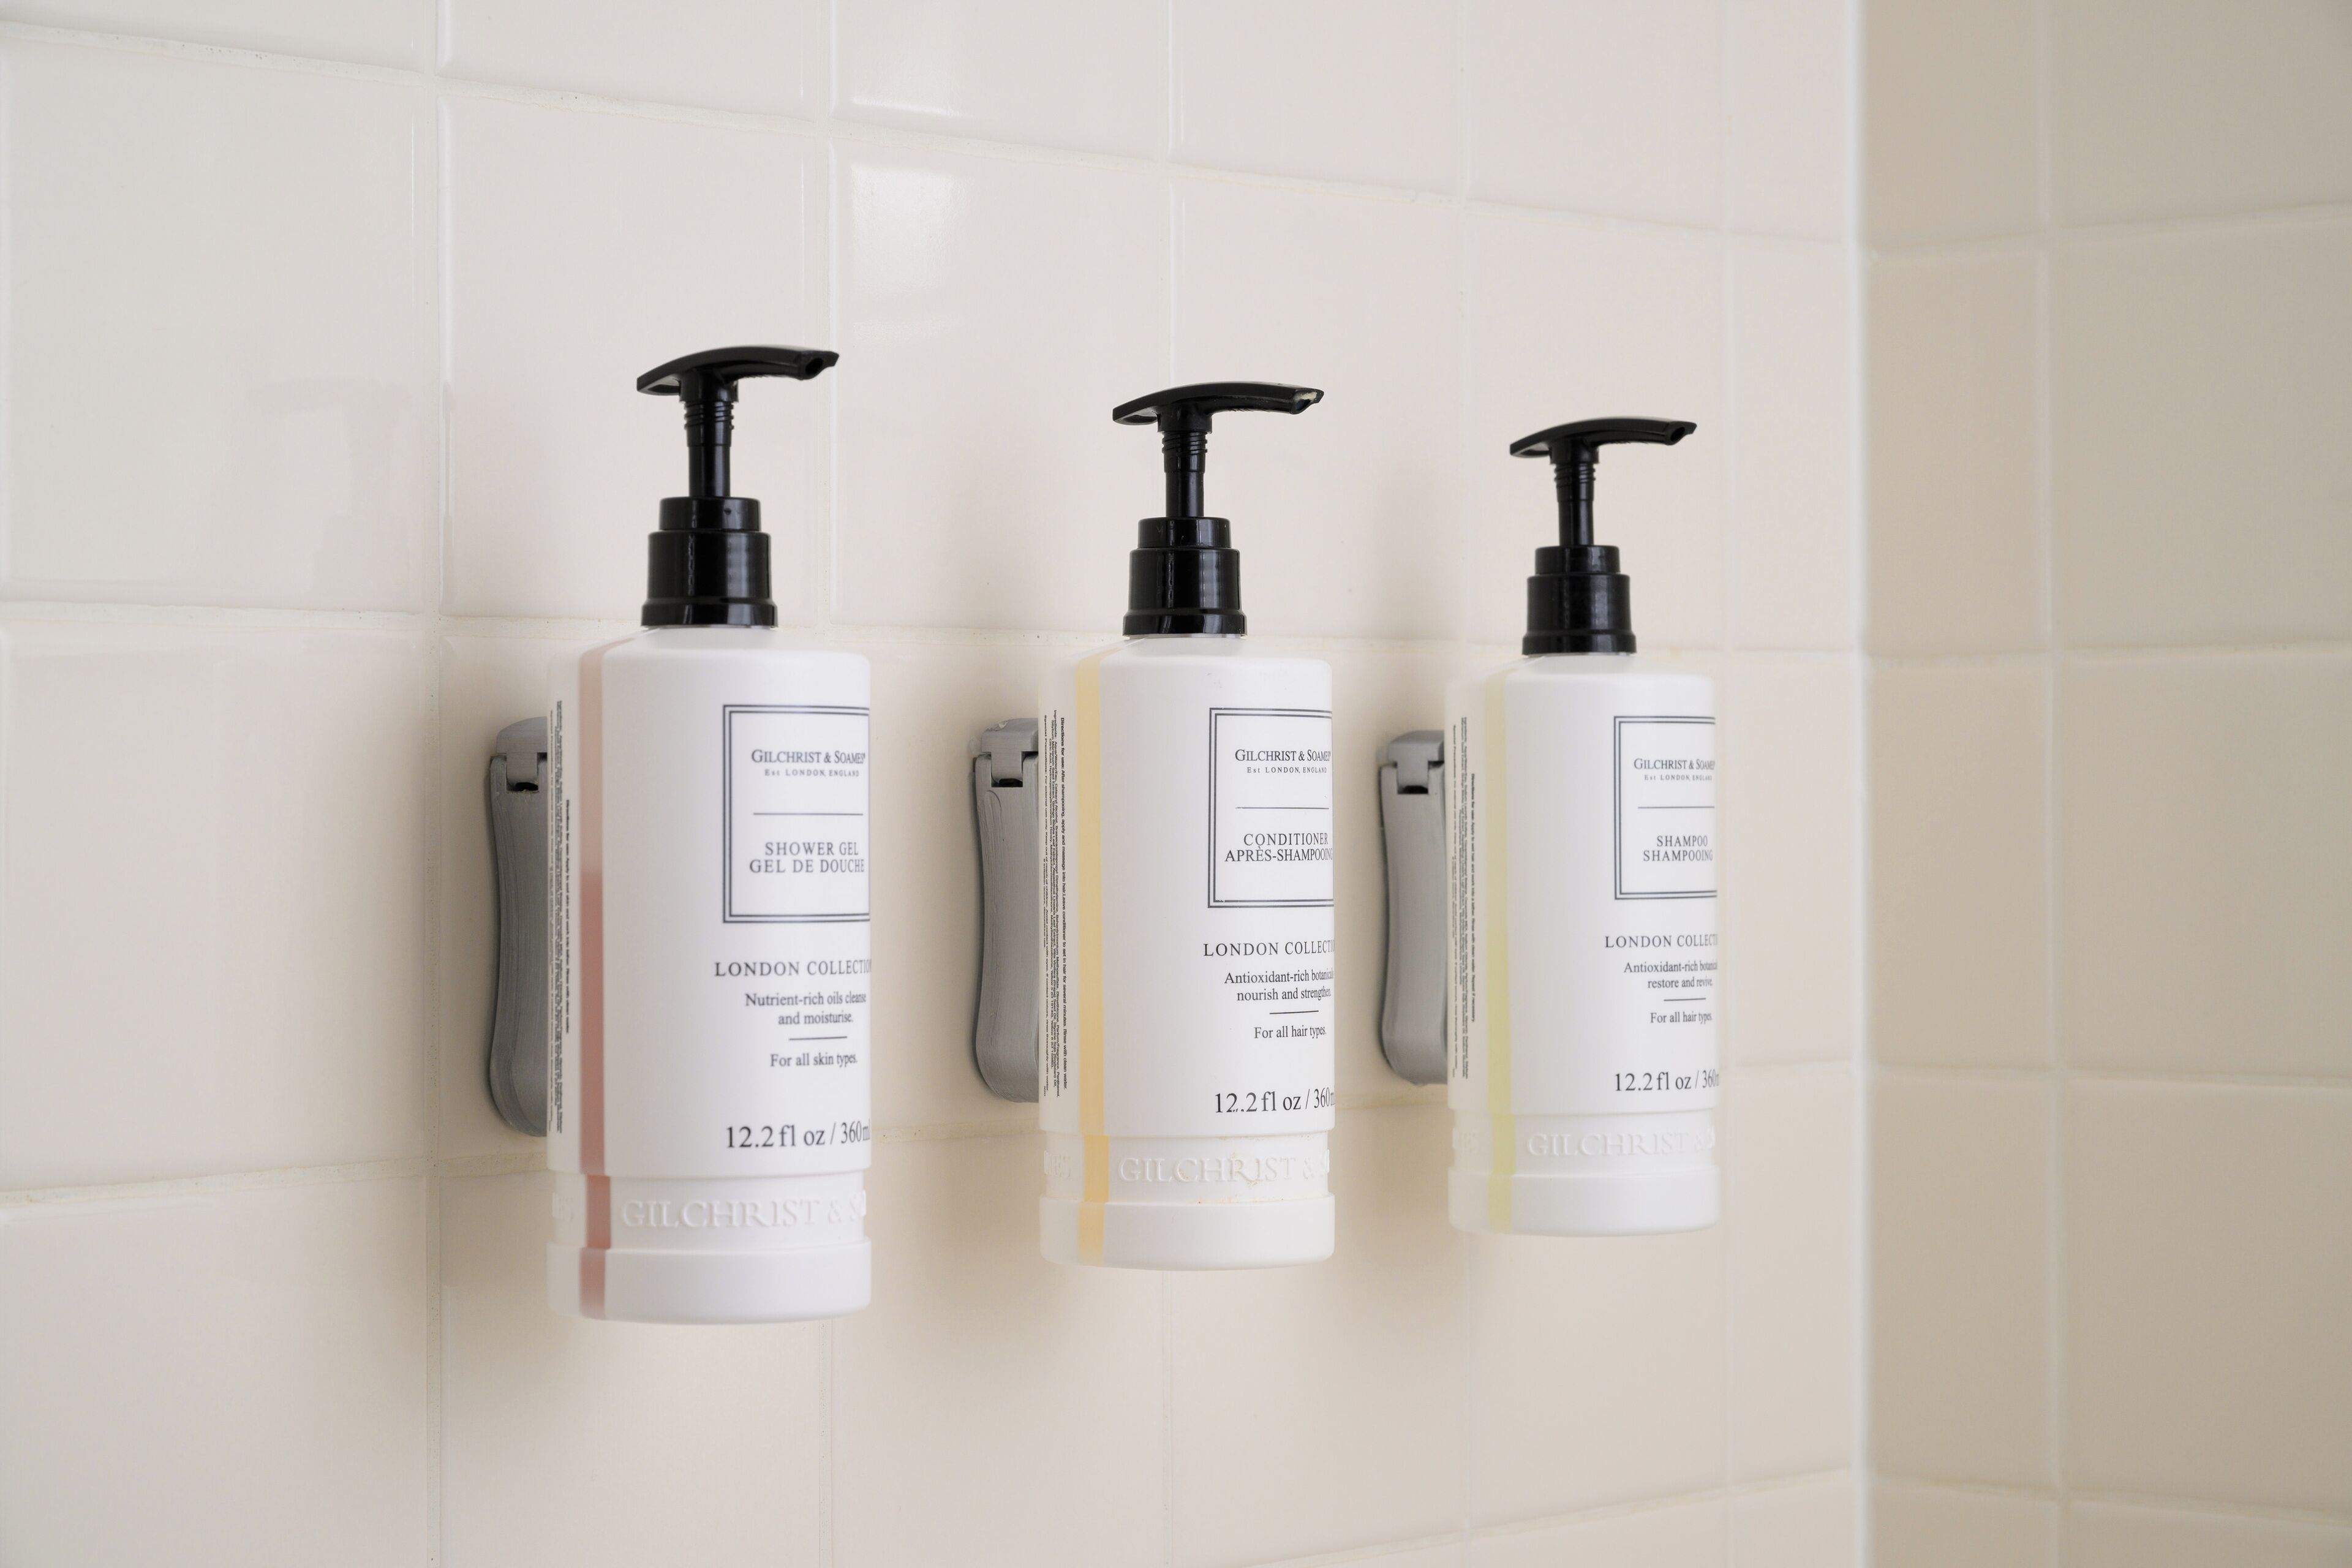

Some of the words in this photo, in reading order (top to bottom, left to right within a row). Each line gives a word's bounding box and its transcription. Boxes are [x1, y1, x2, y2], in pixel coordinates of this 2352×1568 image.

[752, 750, 821, 763] GILCHRIST
[824, 752, 831, 763] &
[1235, 749, 1297, 761] GILCHRIST
[1298, 751, 1305, 761] &
[1634, 758, 1687, 770] GILCHRIST
[1689, 760, 1694, 770] &
[1244, 833, 1329, 846] CONDITIONER
[1657, 835, 1708, 847] SHAMPOO
[765, 842, 834, 856] SHOWER
[839, 842, 858, 856] GEL
[1643, 850, 1713, 862] SHAMPOOING
[750, 859, 786, 873] GEL
[793, 859, 814, 873] DE
[820, 859, 864, 873] DOUCHE
[1605, 935, 1672, 948] LONDON
[1203, 942, 1279, 956] LONDON
[715, 962, 799, 976] LONDON
[1624, 961, 1698, 973] Antioxidant-rich
[1224, 970, 1309, 984] Antioxidant-rich
[1648, 979, 1679, 989] restore
[1682, 977, 1695, 987] and
[745, 992, 824, 1006] Nutrient-rich
[827, 992, 843, 1005] oils
[1237, 988, 1278, 1001] nourish
[1281, 987, 1298, 1000] and
[778, 1012, 800, 1025] and
[804, 1011, 853, 1024] moisturise.
[1650, 1012, 1667, 1023] For
[1670, 1012, 1680, 1022] all
[1683, 1011, 1697, 1022] hair
[1254, 1027, 1273, 1038] For
[1276, 1026, 1288, 1038] all
[1291, 1025, 1307, 1037] hair
[1310, 1026, 1326, 1039] types.
[770, 1054, 792, 1066] For
[796, 1053, 809, 1066] all
[813, 1052, 833, 1065] skin
[837, 1054, 858, 1068] types.
[1615, 1073, 1653, 1091] 12.2
[1656, 1072, 1669, 1090] fl
[1675, 1076, 1691, 1090] oz
[1695, 1070, 1699, 1089] /
[1215, 1092, 1257, 1113] 12.2
[1261, 1091, 1277, 1112] fl
[1283, 1096, 1301, 1110] oz
[1305, 1089, 1310, 1109] /
[727, 1126, 774, 1148] 12.2
[779, 1125, 796, 1147] fl
[804, 1129, 825, 1146] oz
[830, 1123, 836, 1145] /
[1529, 1131, 1689, 1156] GILCHRIST
[1118, 1156, 1296, 1183] GILCHRIST
[622, 1199, 820, 1228] GILCHRIST
